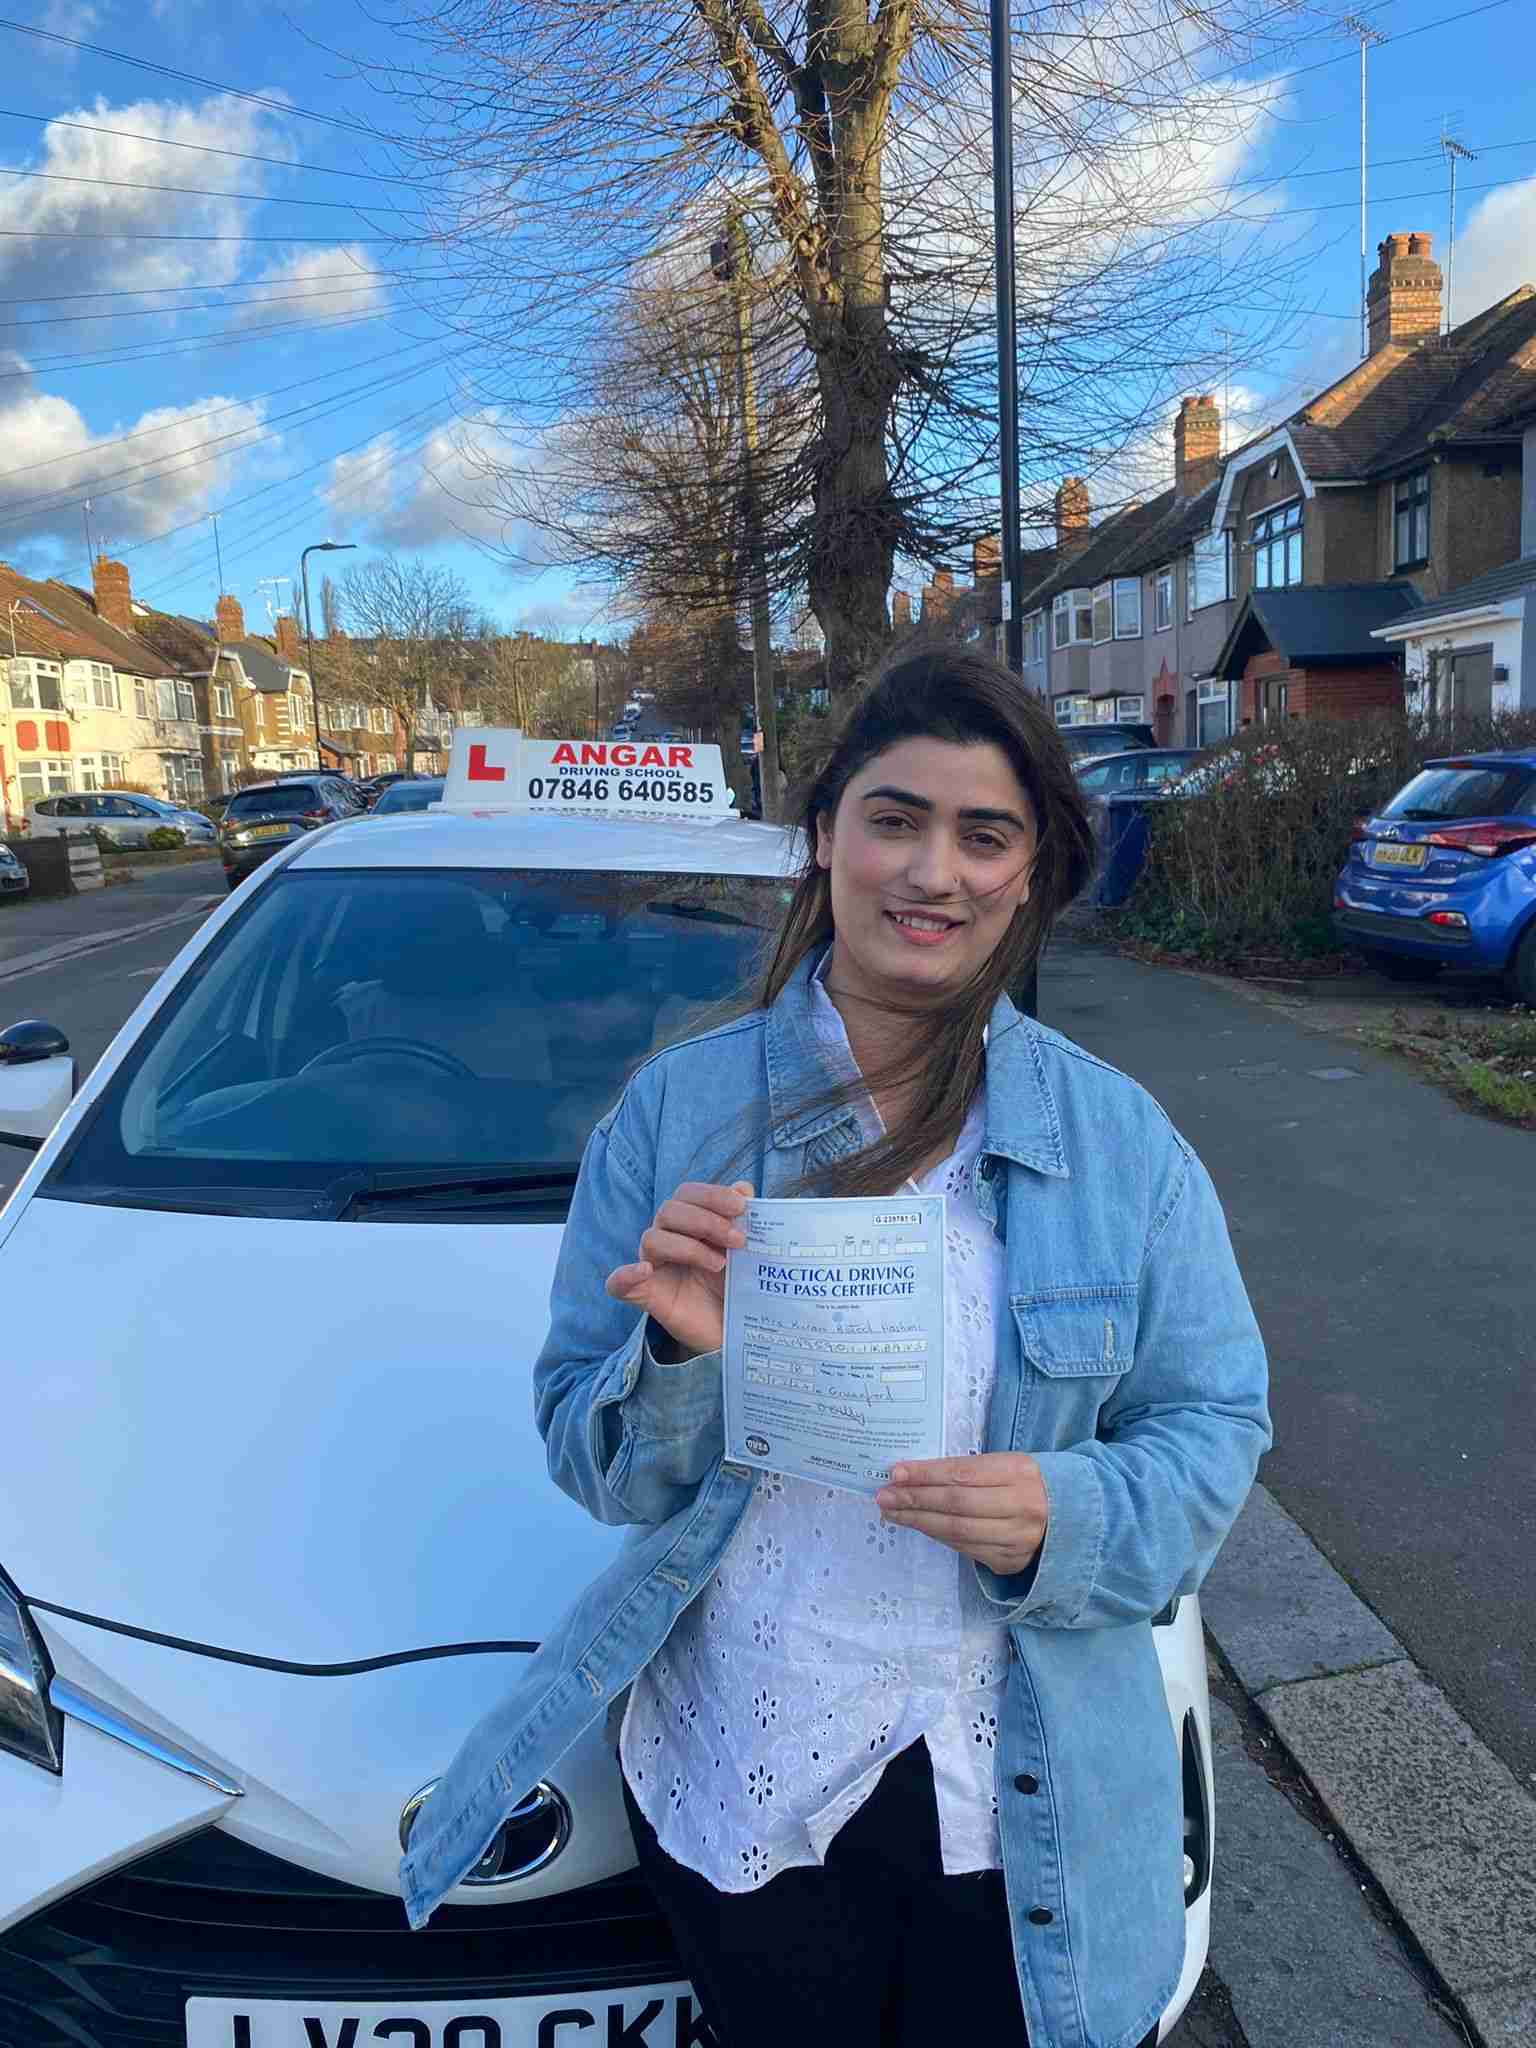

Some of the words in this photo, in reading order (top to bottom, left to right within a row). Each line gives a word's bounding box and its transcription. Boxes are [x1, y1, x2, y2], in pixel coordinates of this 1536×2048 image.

[468, 744, 505, 781] L
[551, 743, 694, 768] ANGAR
[560, 767, 620, 777] DRIVING
[625, 768, 684, 778] SCHOOL
[529, 778, 609, 800] 07846
[619, 780, 714, 803] 640585
[758, 1263, 843, 1282] PRACTICAL
[849, 1265, 914, 1281] DRIVING
[759, 1279, 791, 1294] TEST
[794, 1284, 827, 1297] PASS
[831, 1282, 915, 1297] CERTIFICATE
